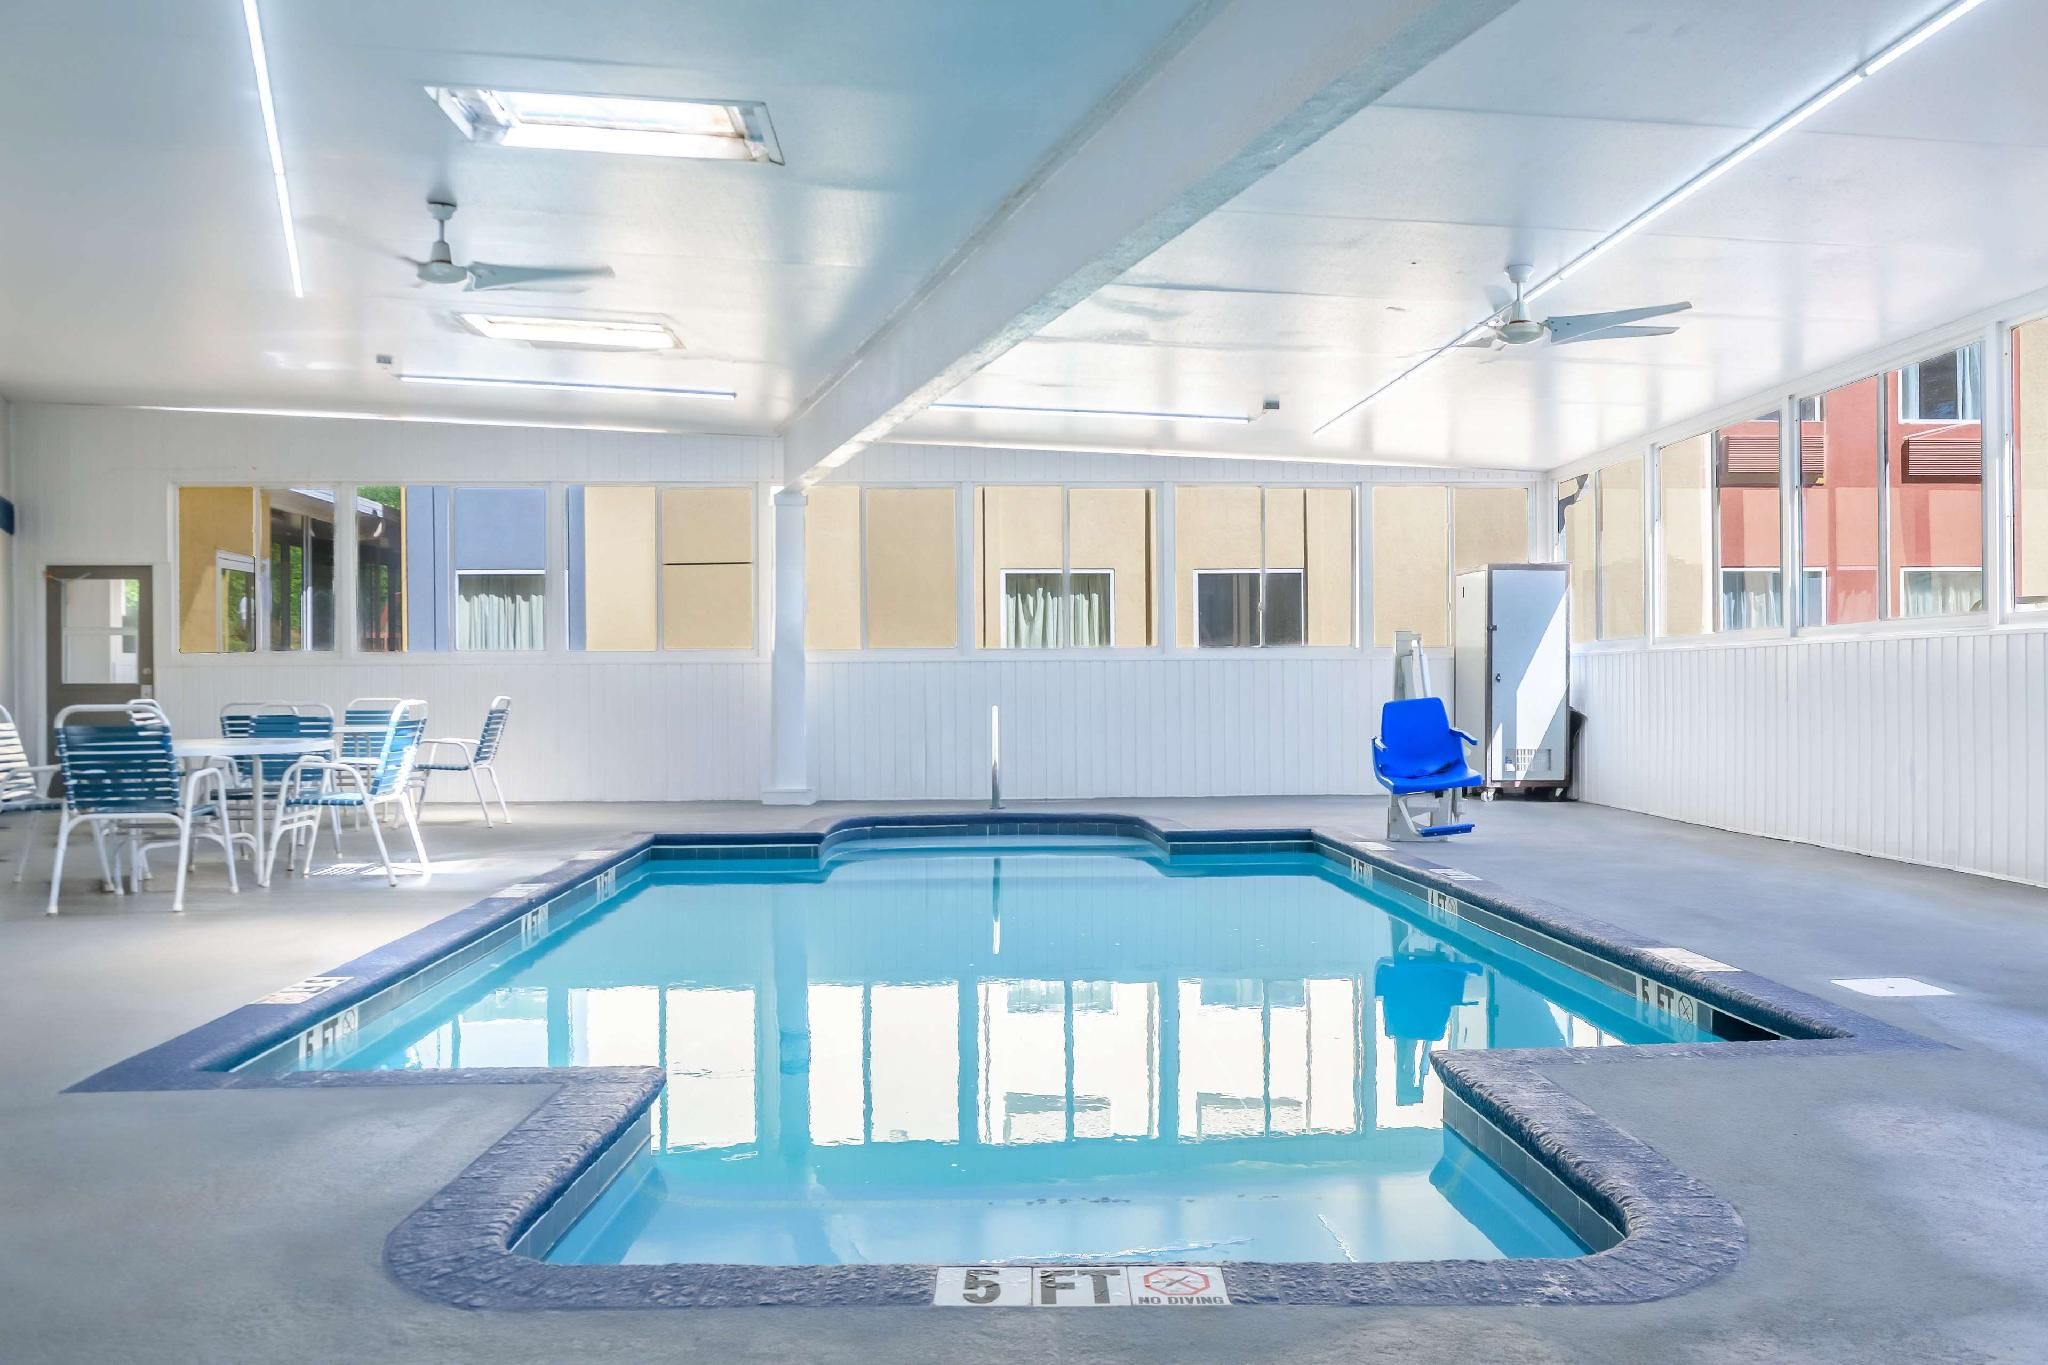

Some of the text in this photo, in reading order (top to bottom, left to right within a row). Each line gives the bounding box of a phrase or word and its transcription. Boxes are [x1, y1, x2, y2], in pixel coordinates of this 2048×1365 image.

[963, 1269, 1121, 1304] 5 FT
[1138, 1296, 1224, 1304] NO DIVING
